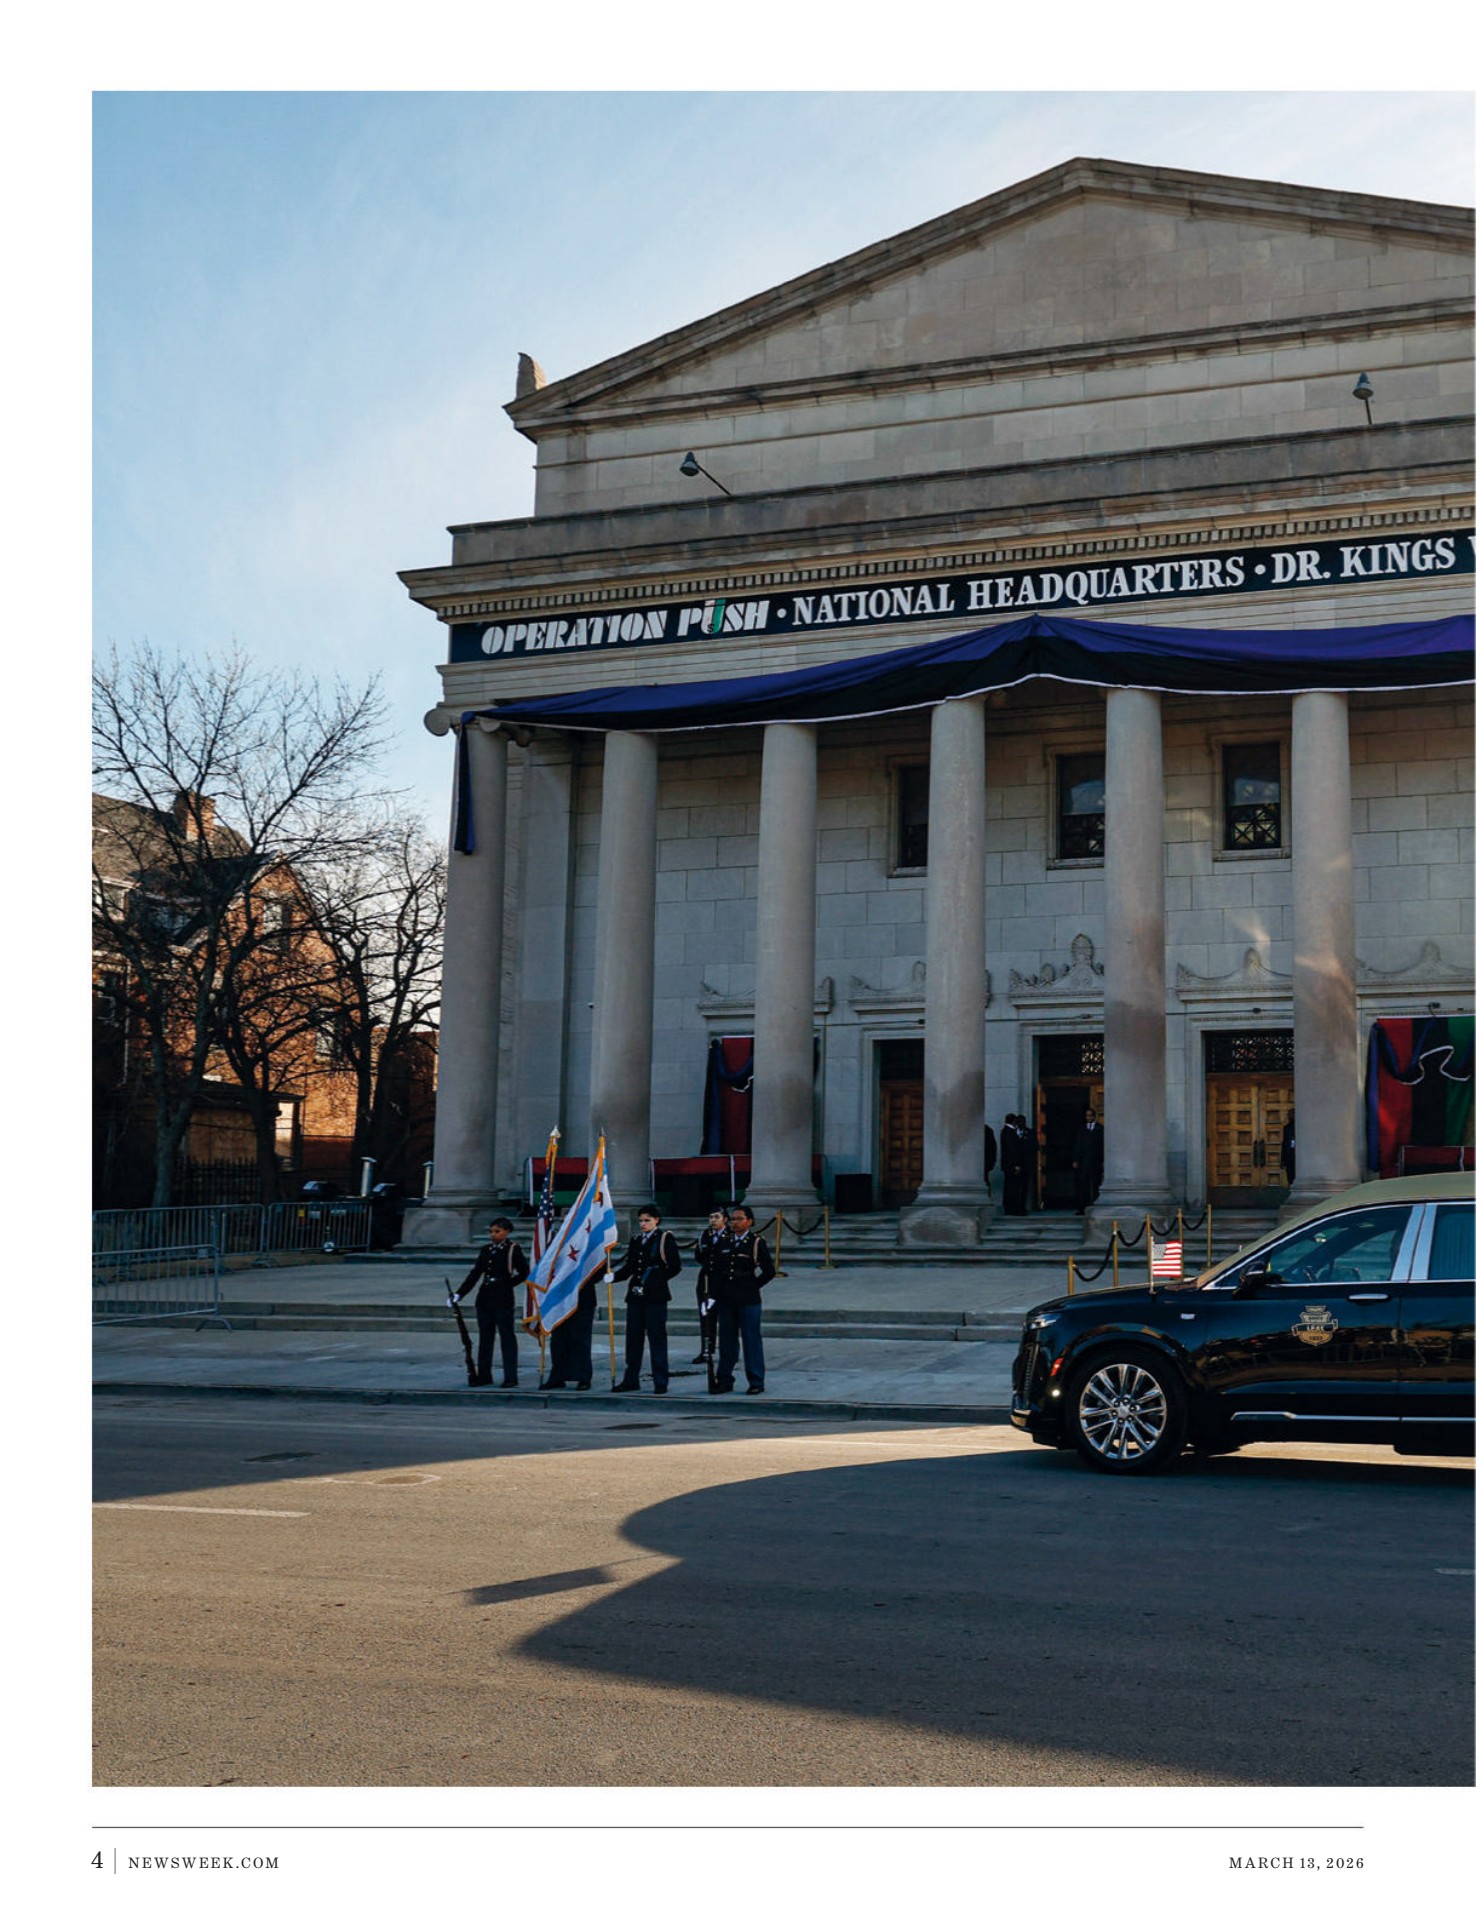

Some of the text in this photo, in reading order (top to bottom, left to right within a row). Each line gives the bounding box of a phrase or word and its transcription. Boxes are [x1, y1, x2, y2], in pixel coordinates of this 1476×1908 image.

[481, 610, 667, 655] OPERATION
[677, 598, 770, 636] PUSH
[792, 583, 955, 626] NATIONAL
[966, 556, 1245, 610] HEADQUARTERS
[1271, 550, 1331, 584] DR.
[1339, 537, 1456, 578] KINGS
